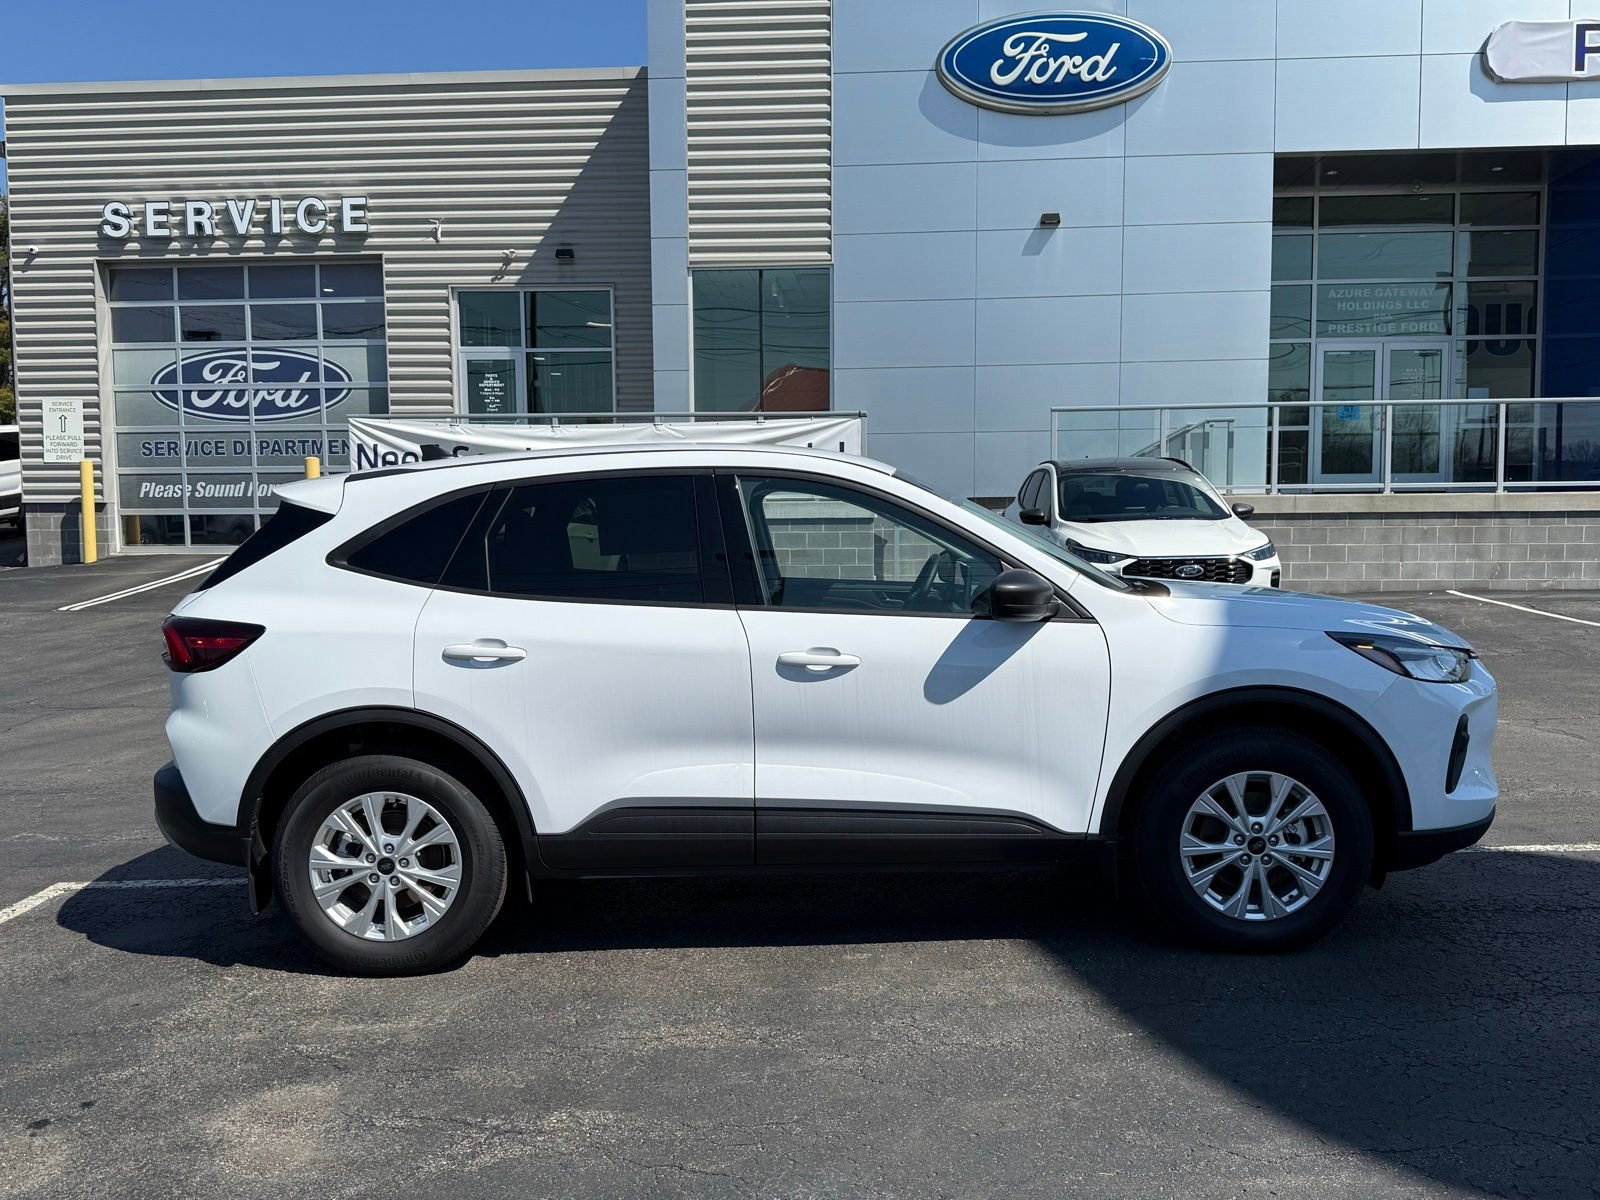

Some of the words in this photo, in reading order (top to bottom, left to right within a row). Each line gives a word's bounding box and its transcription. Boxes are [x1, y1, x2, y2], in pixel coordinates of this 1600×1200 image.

[989, 31, 1121, 87] Ford
[102, 196, 368, 238] SERVICE
[1328, 288, 1371, 298] AZURE
[1375, 286, 1434, 297] GATEWAY
[1336, 300, 1402, 311] HOLDINGS
[1406, 300, 1430, 309] LLC
[1328, 322, 1396, 334] PRESTIGE
[1400, 321, 1438, 332] FORD
[190, 359, 312, 409] Ford
[232, 438, 350, 456] DEPARTMEN
[139, 481, 193, 498] Please
[195, 481, 246, 498] Sound
